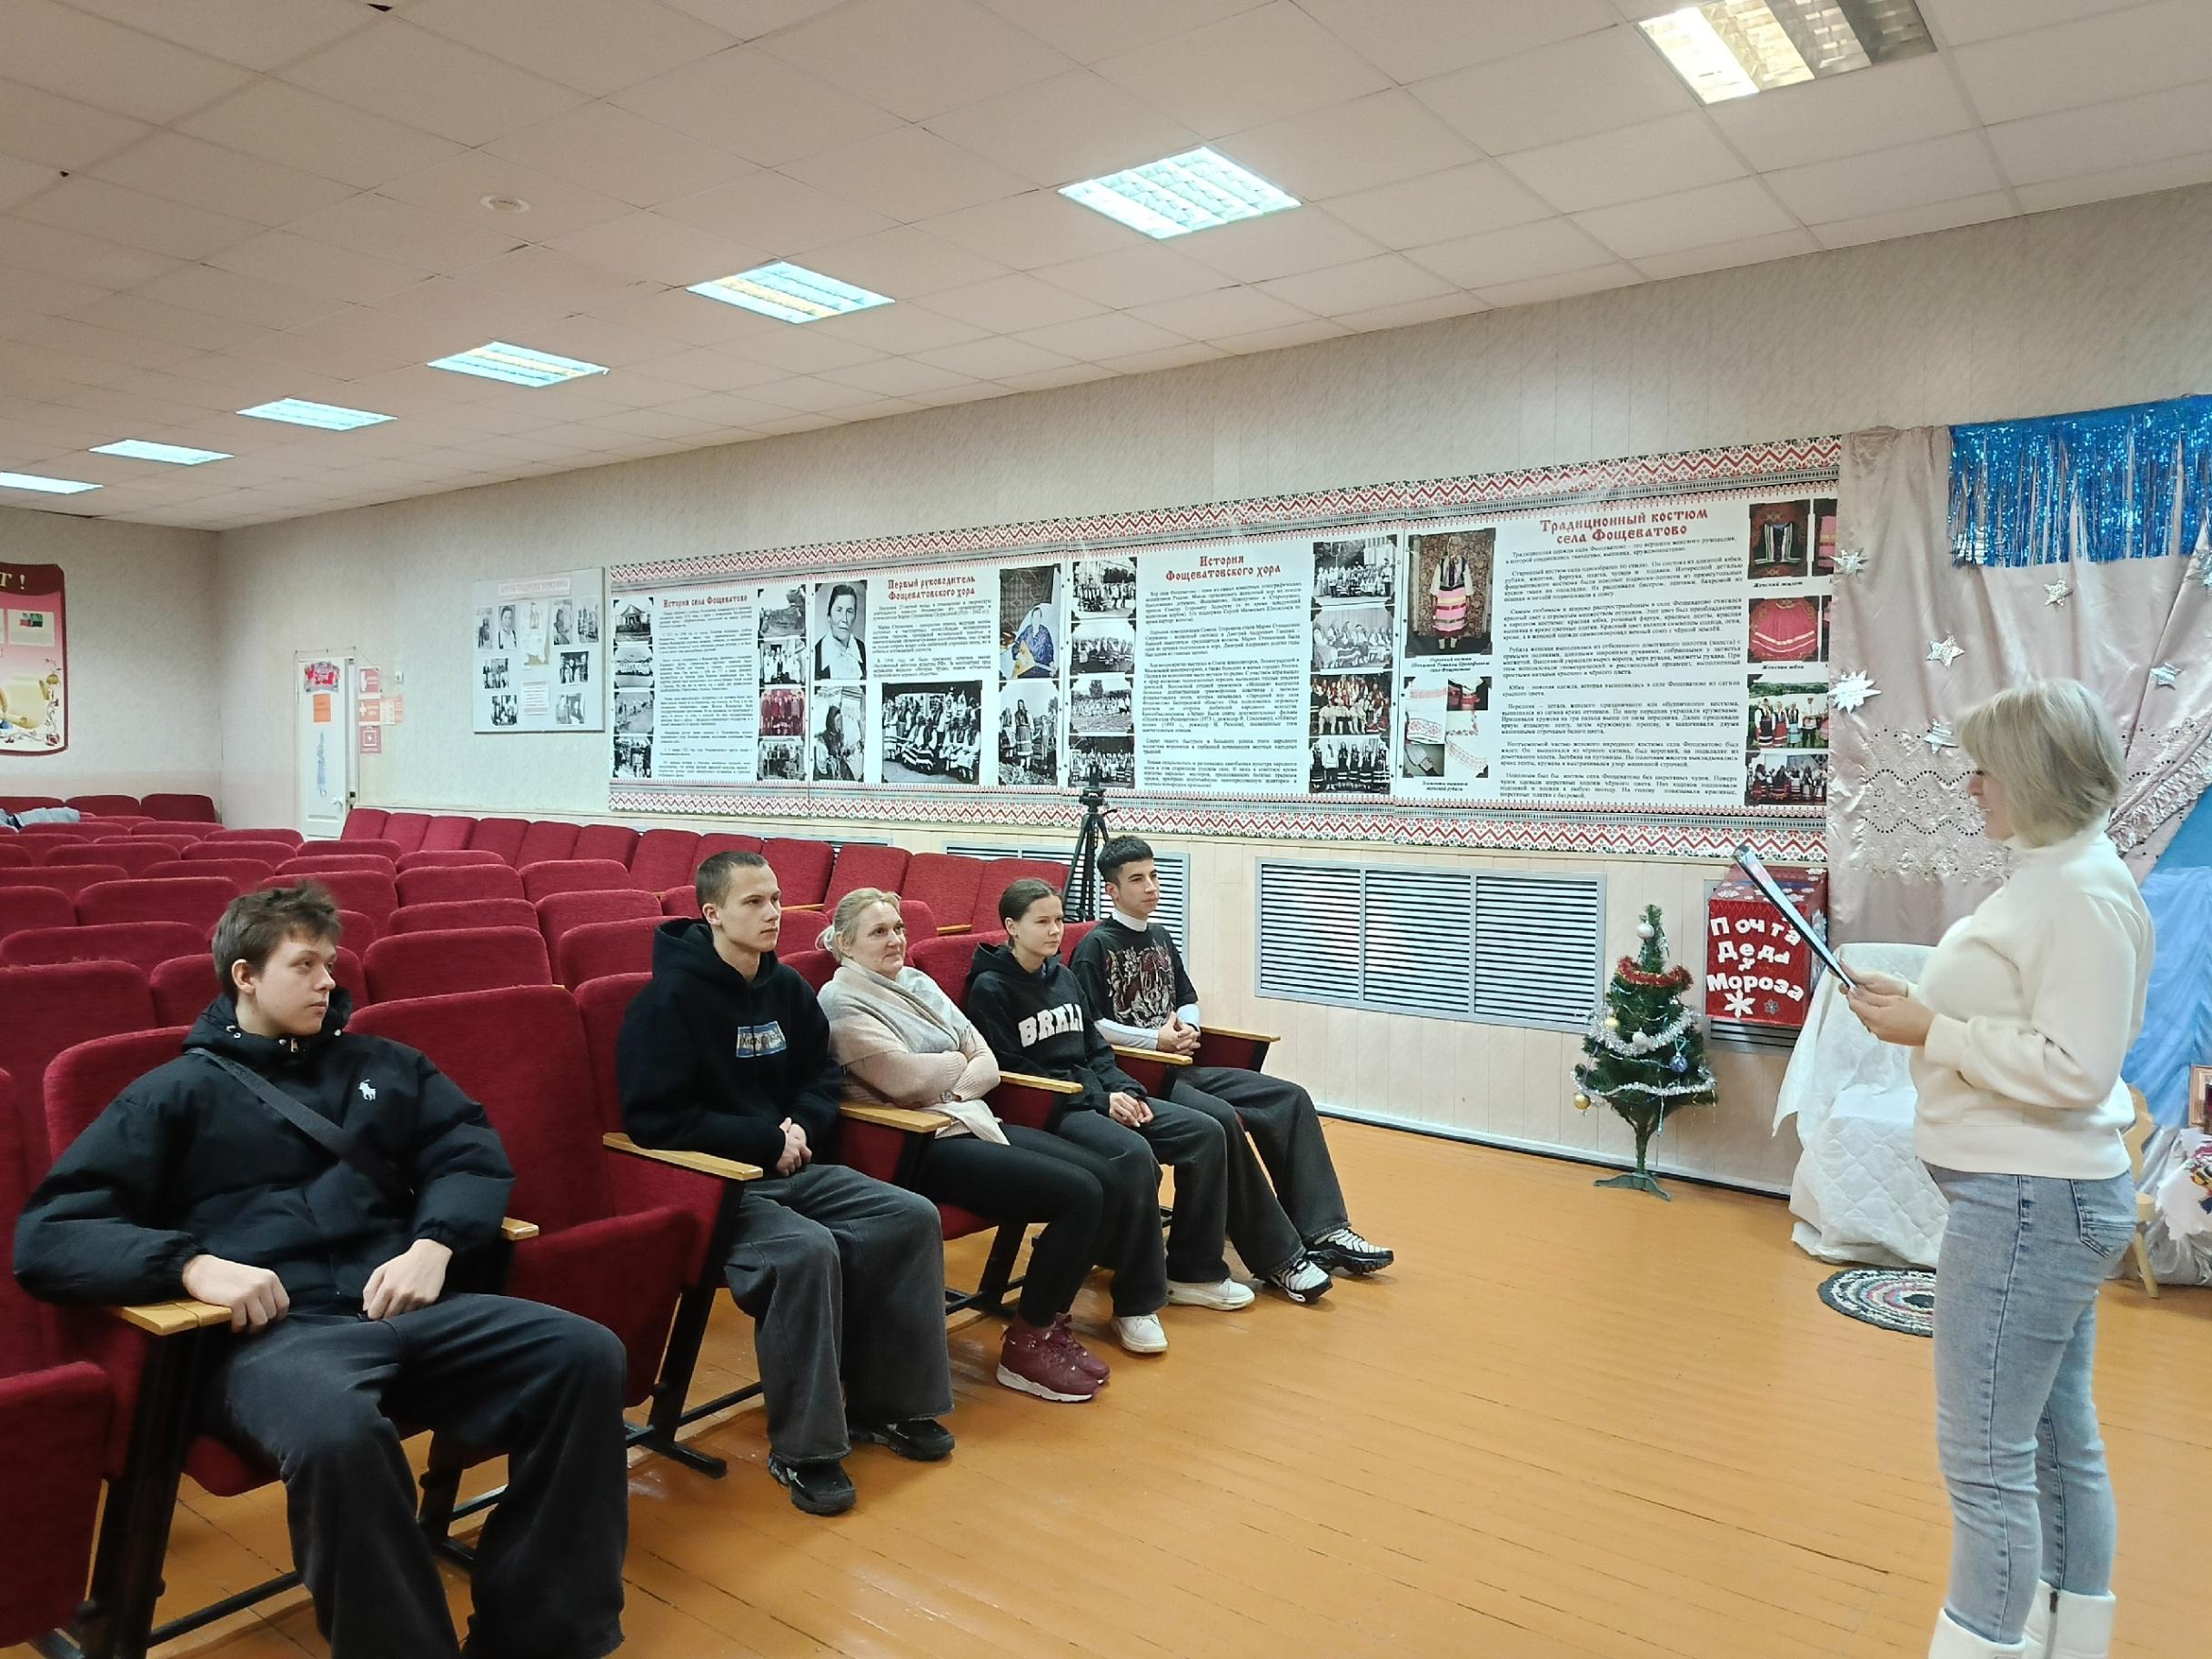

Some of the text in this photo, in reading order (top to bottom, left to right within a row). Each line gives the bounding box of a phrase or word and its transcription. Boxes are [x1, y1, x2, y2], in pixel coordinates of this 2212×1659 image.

[1540, 508, 1708, 534] Традиционный костюм
[1556, 526, 1687, 544] села Фощеватово
[1200, 556, 1244, 568] История
[1165, 565, 1281, 581] Фощеватовского хора
[888, 576, 976, 590] Первый руководитель
[888, 588, 976, 600] Фощеватовского хора
[1710, 916, 1801, 946] Почта
[1717, 940, 1790, 964] Деда
[1707, 973, 1805, 1001] Мороза
